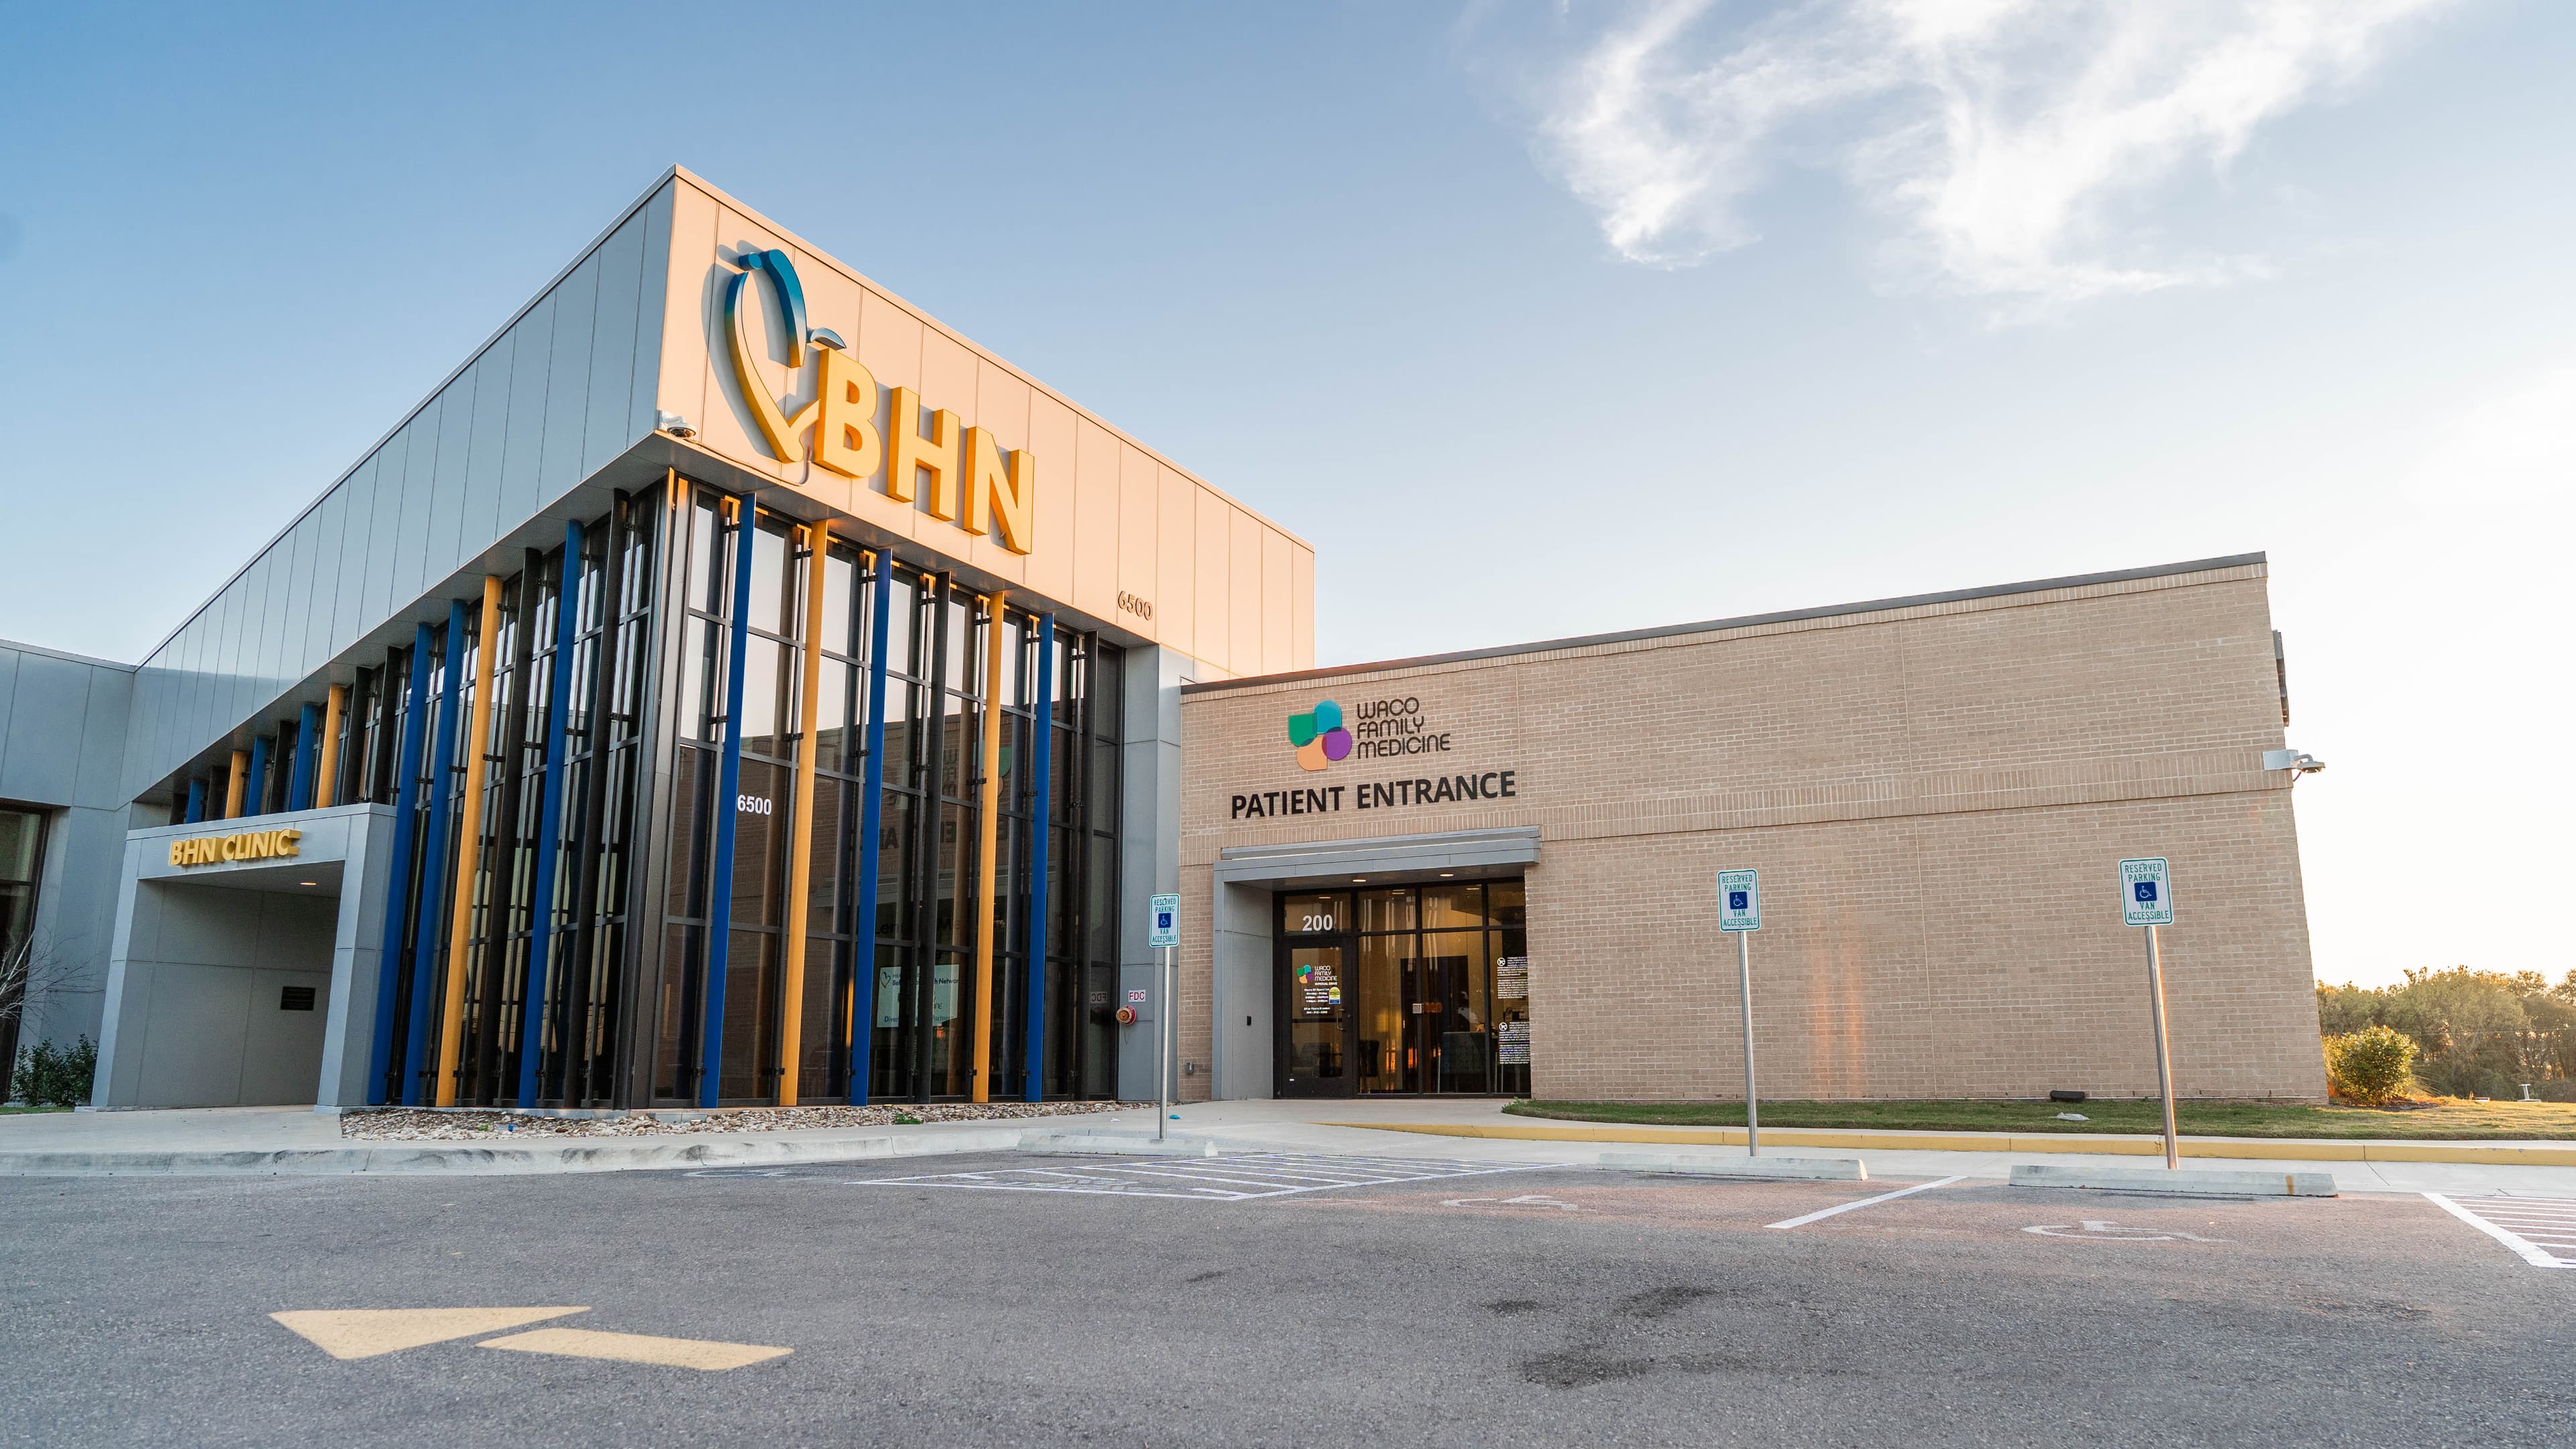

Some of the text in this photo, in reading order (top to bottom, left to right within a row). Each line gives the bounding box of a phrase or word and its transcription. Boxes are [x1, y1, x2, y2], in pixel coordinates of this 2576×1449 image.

[814, 348, 1034, 555] BHN
[1118, 590, 1153, 621] 6500
[1357, 697, 1420, 720] WACO
[1357, 716, 1425, 739] FAMILY
[1357, 733, 1451, 759] MEDICINE
[1232, 771, 1516, 819] PATIENT ENTRANCE
[737, 794, 772, 815] 6500
[169, 828, 301, 865] BHN CLINIC
[2125, 863, 2162, 873] RESERVED
[1722, 874, 1753, 883] RESERVED
[2128, 873, 2161, 882] PARKING
[1725, 883, 1752, 892] PARKING
[1154, 898, 1177, 906] RESERVED
[2139, 902, 2155, 910] VAN
[2128, 910, 2169, 920] ACCESSIBLE
[1302, 914, 1333, 932] 200
[1723, 917, 1758, 926] ACCESSIBLE
[1152, 934, 1177, 943] ACCESSIBLE
[1129, 991, 1145, 1001] FDC
